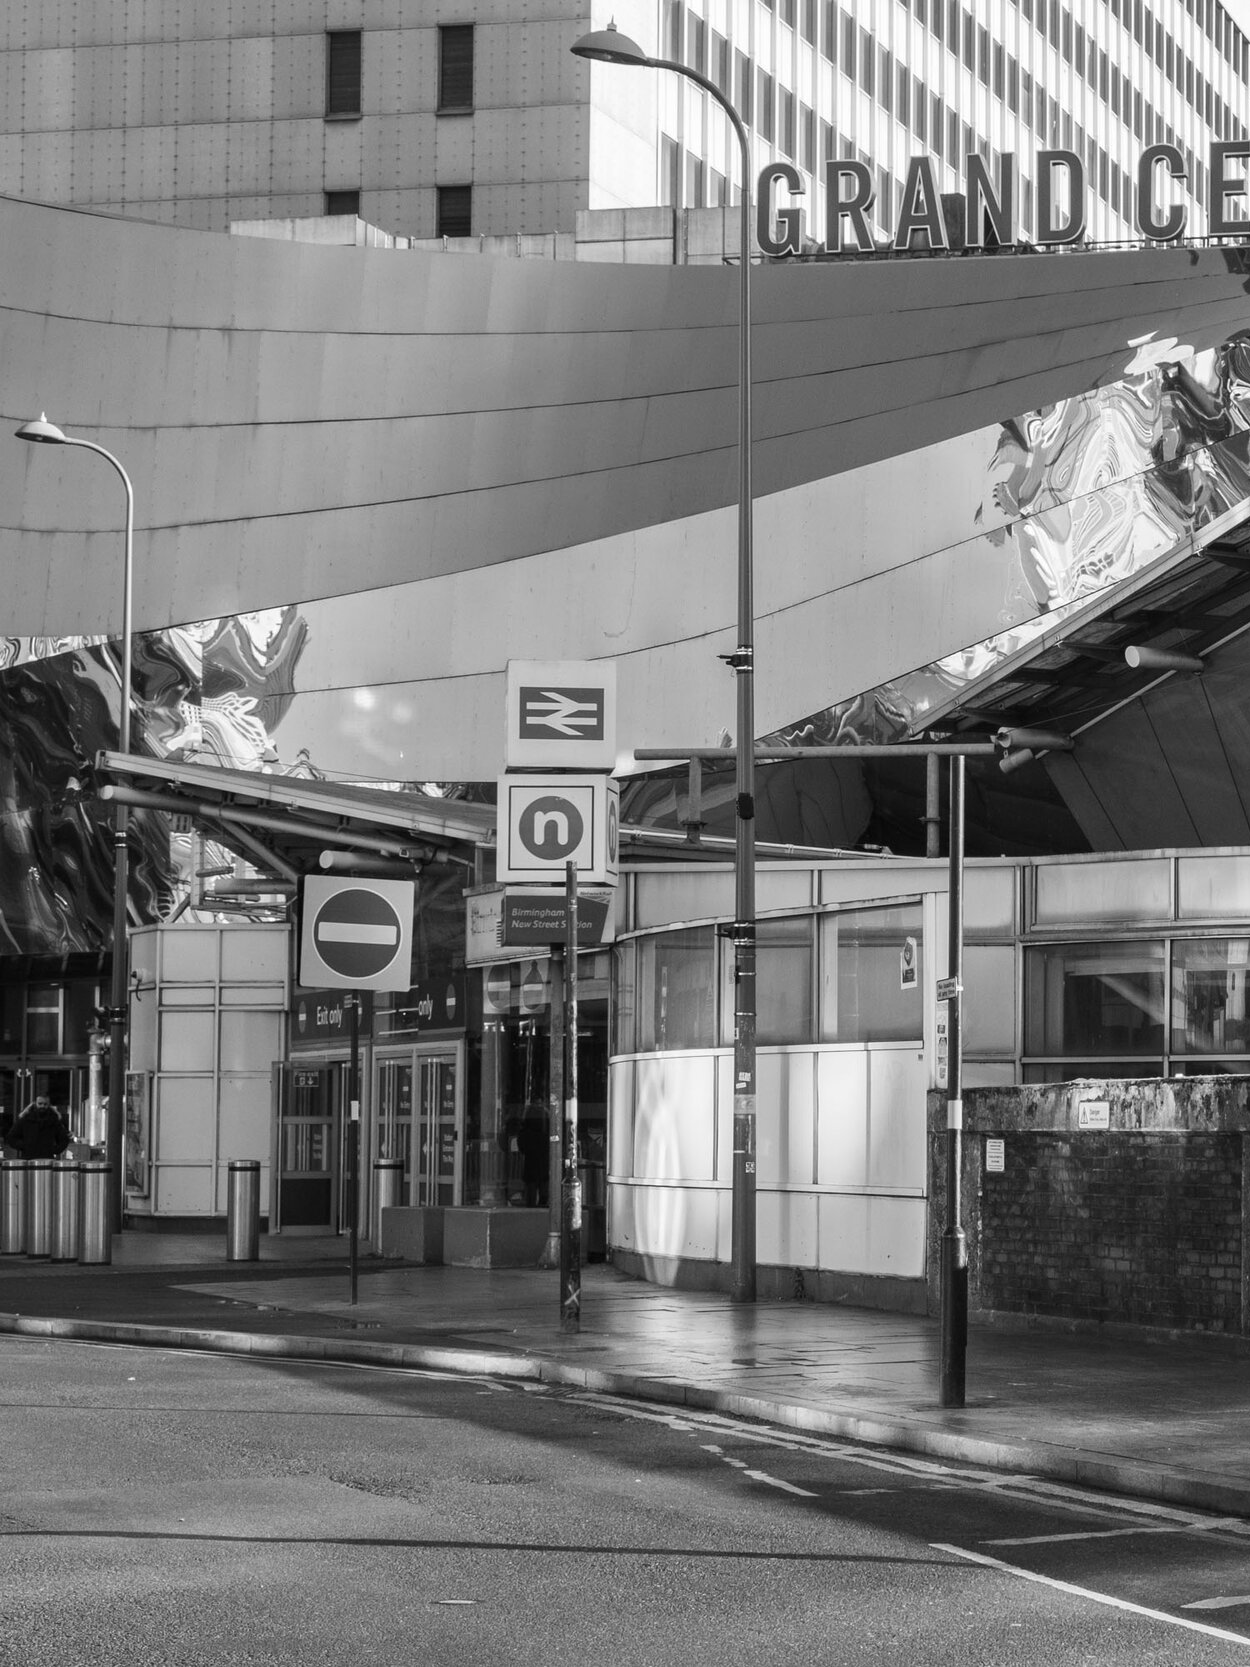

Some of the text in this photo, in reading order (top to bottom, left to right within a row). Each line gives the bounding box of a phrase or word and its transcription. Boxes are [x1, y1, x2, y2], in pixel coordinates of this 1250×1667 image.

[755, 148, 1088, 258] GRAND
[533, 810, 569, 846] n
[511, 907, 565, 918] Birmingham
[511, 920, 532, 929] New
[532, 920, 560, 929] Street
[316, 1003, 343, 1029] Exit only
[418, 993, 434, 1021] only
